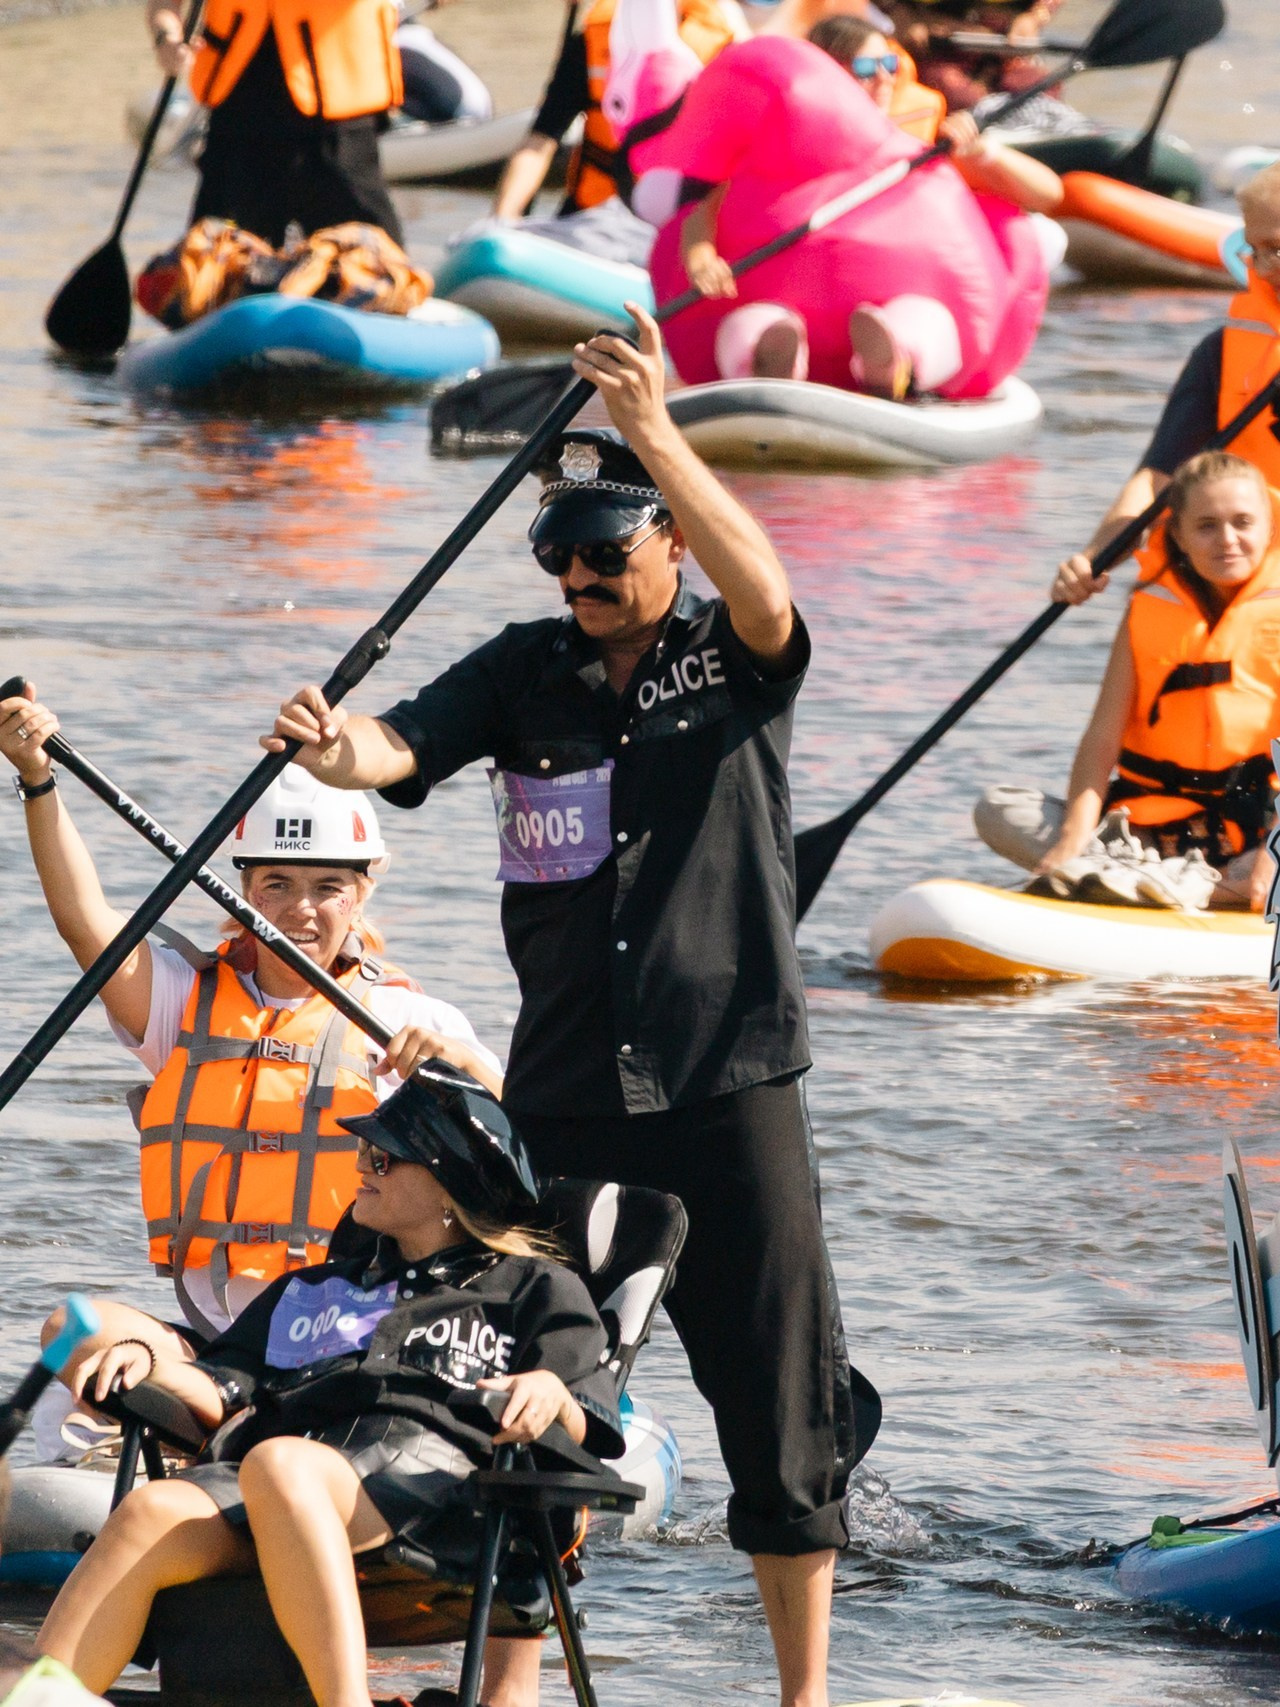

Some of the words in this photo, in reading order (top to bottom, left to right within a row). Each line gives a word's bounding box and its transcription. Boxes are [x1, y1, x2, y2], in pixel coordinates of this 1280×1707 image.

[274, 840, 311, 851] НИКС
[516, 806, 585, 849] 0905
[404, 1317, 516, 1371] POLICE
